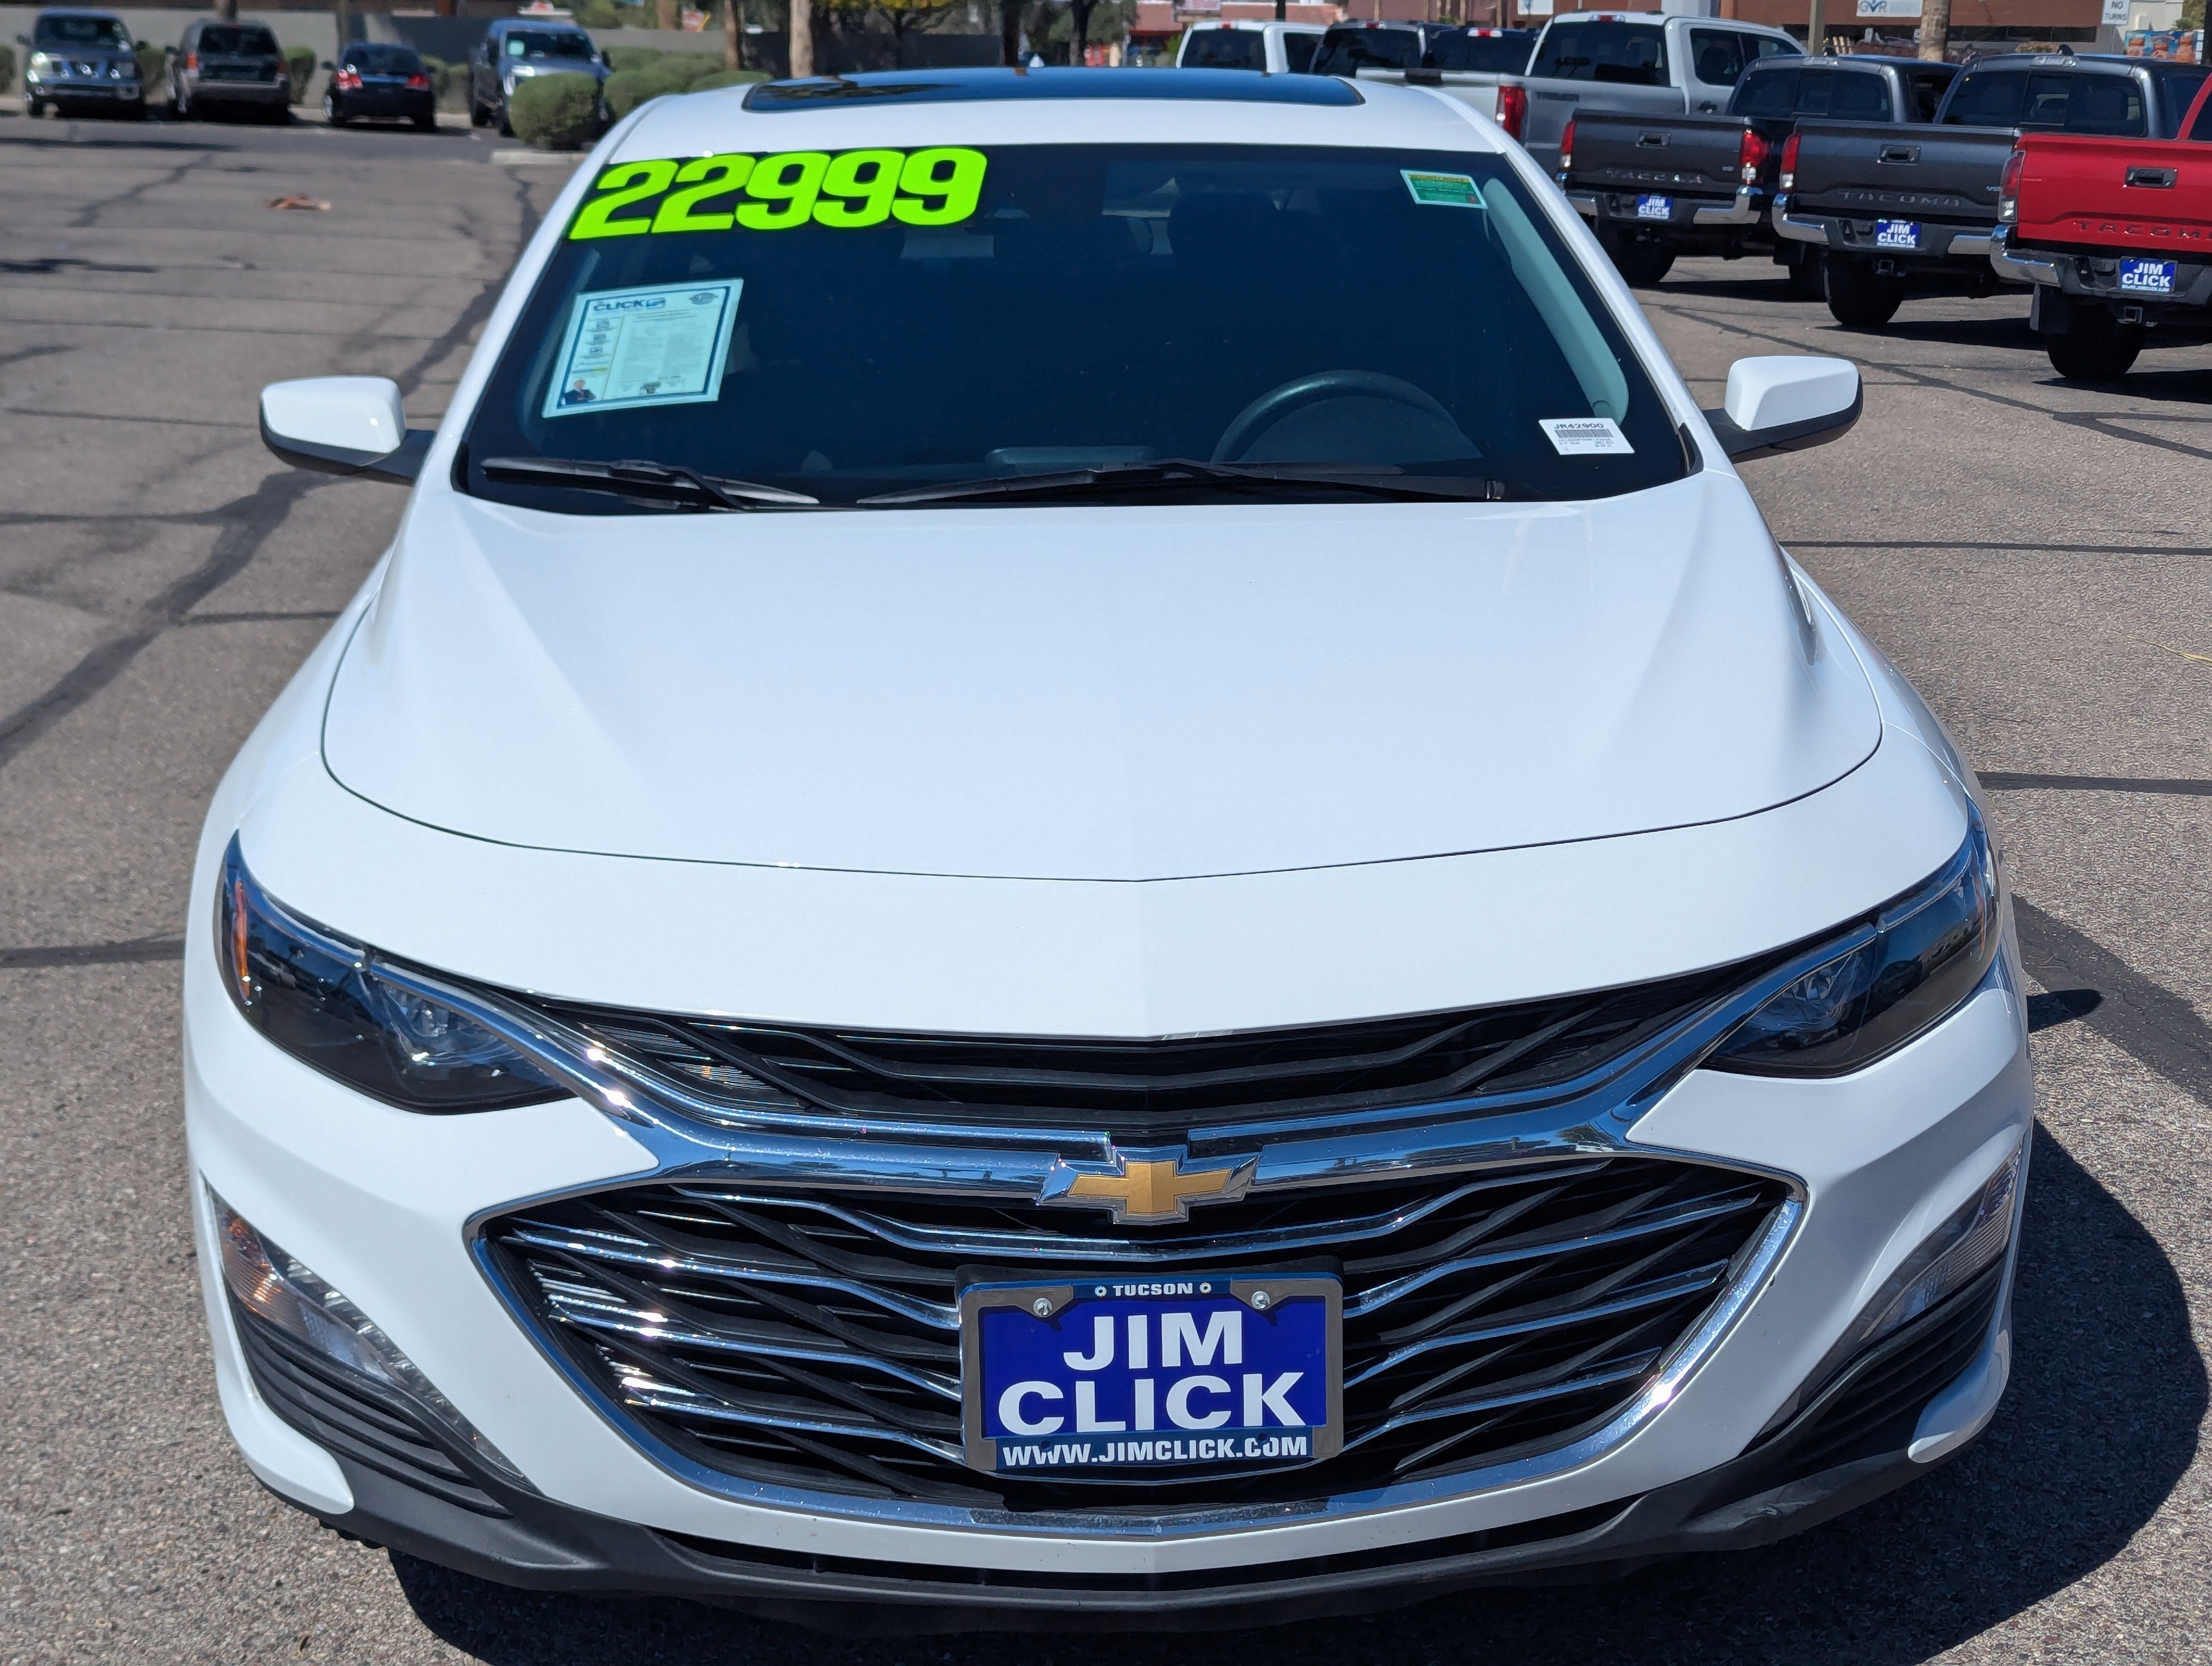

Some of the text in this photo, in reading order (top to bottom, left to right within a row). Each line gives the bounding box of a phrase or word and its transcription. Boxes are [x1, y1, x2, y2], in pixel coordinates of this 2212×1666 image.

[2111, 1, 2123, 9] NO
[568, 147, 988, 240] 22999
[1838, 191, 1959, 206] TACOMA
[1646, 198, 1666, 207] JIM
[1638, 204, 1670, 216] CLICK
[1887, 223, 1910, 234] JIM
[1877, 232, 1916, 245] CLICK
[2133, 262, 2163, 275] JIM
[2122, 273, 2171, 287] CLICK
[1113, 1283, 1193, 1296] TUCSON
[1063, 1311, 1243, 1371] JIM
[998, 1372, 1307, 1436] CLICK
[1003, 1436, 1307, 1466] WWW.JIMCLICK.COM
